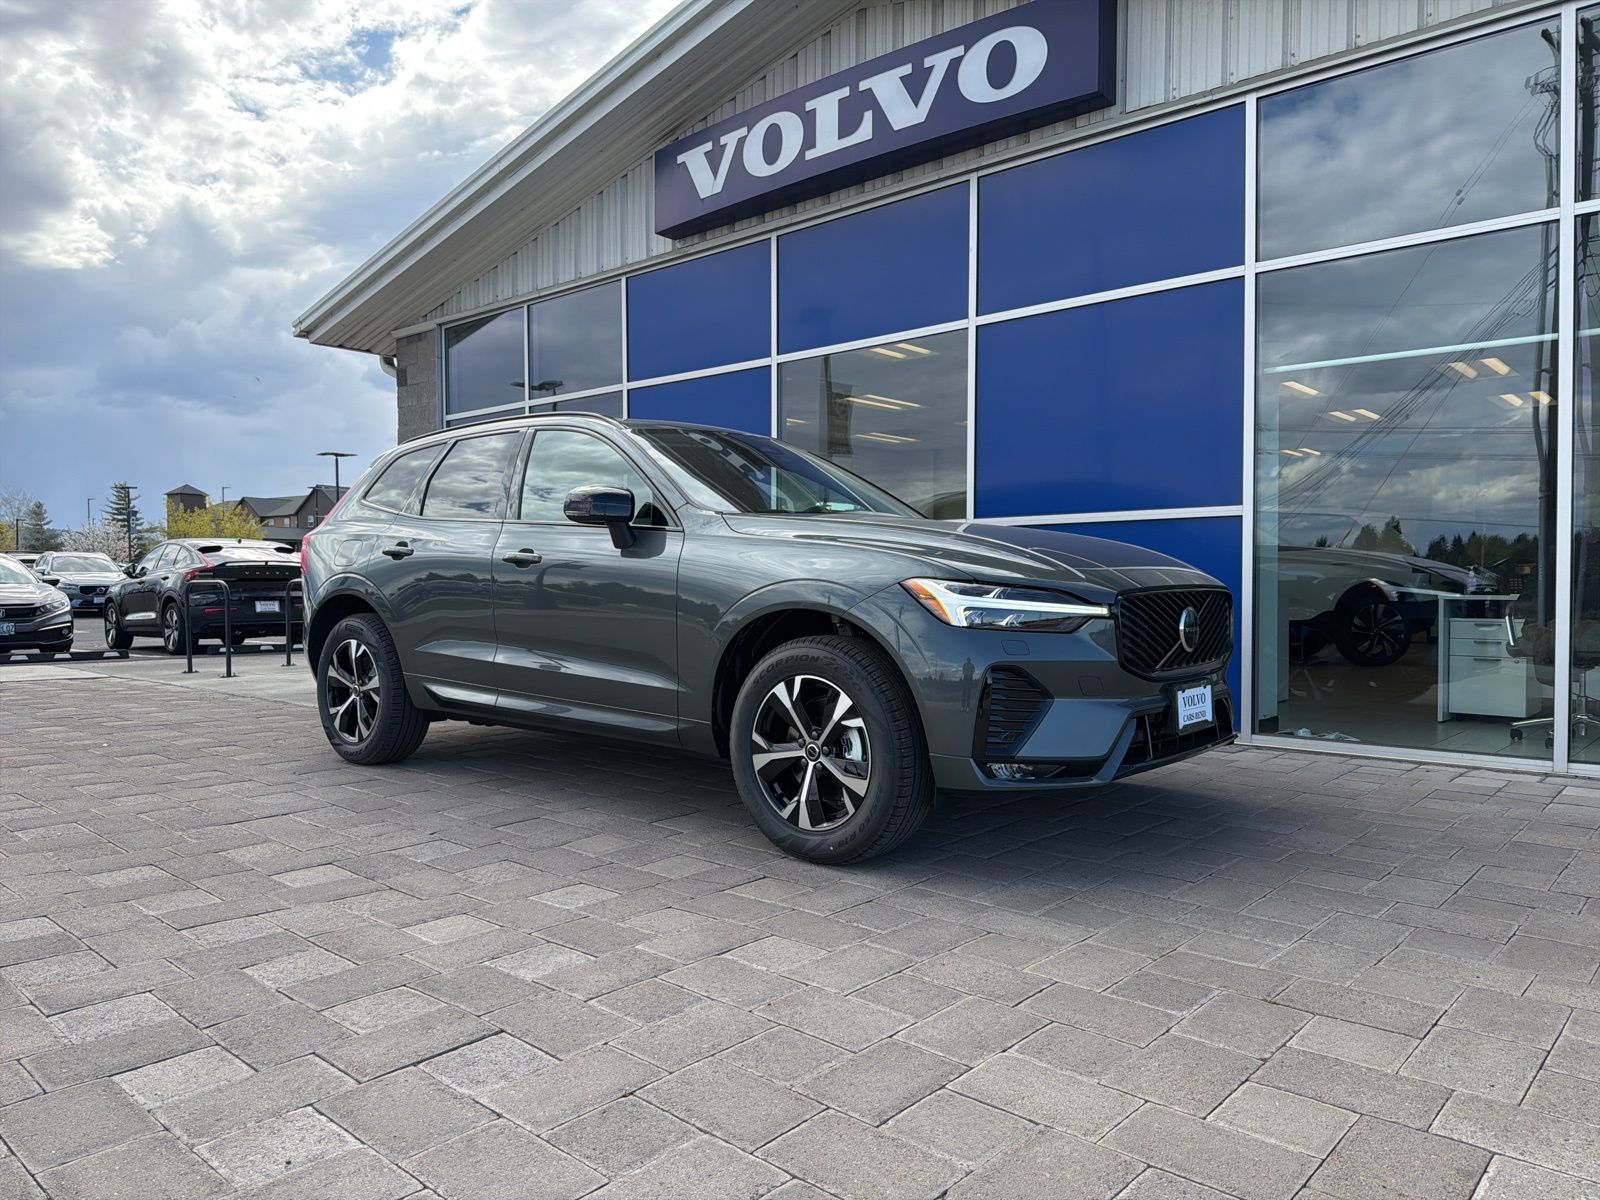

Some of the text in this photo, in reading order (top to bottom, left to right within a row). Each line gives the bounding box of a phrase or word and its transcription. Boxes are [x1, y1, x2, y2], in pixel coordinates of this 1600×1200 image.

[676, 25, 1049, 200] VOLVO
[753, 654, 820, 689] SCORPION
[1182, 692, 1206, 708] VOLVO
[1183, 712, 1195, 722] CARS
